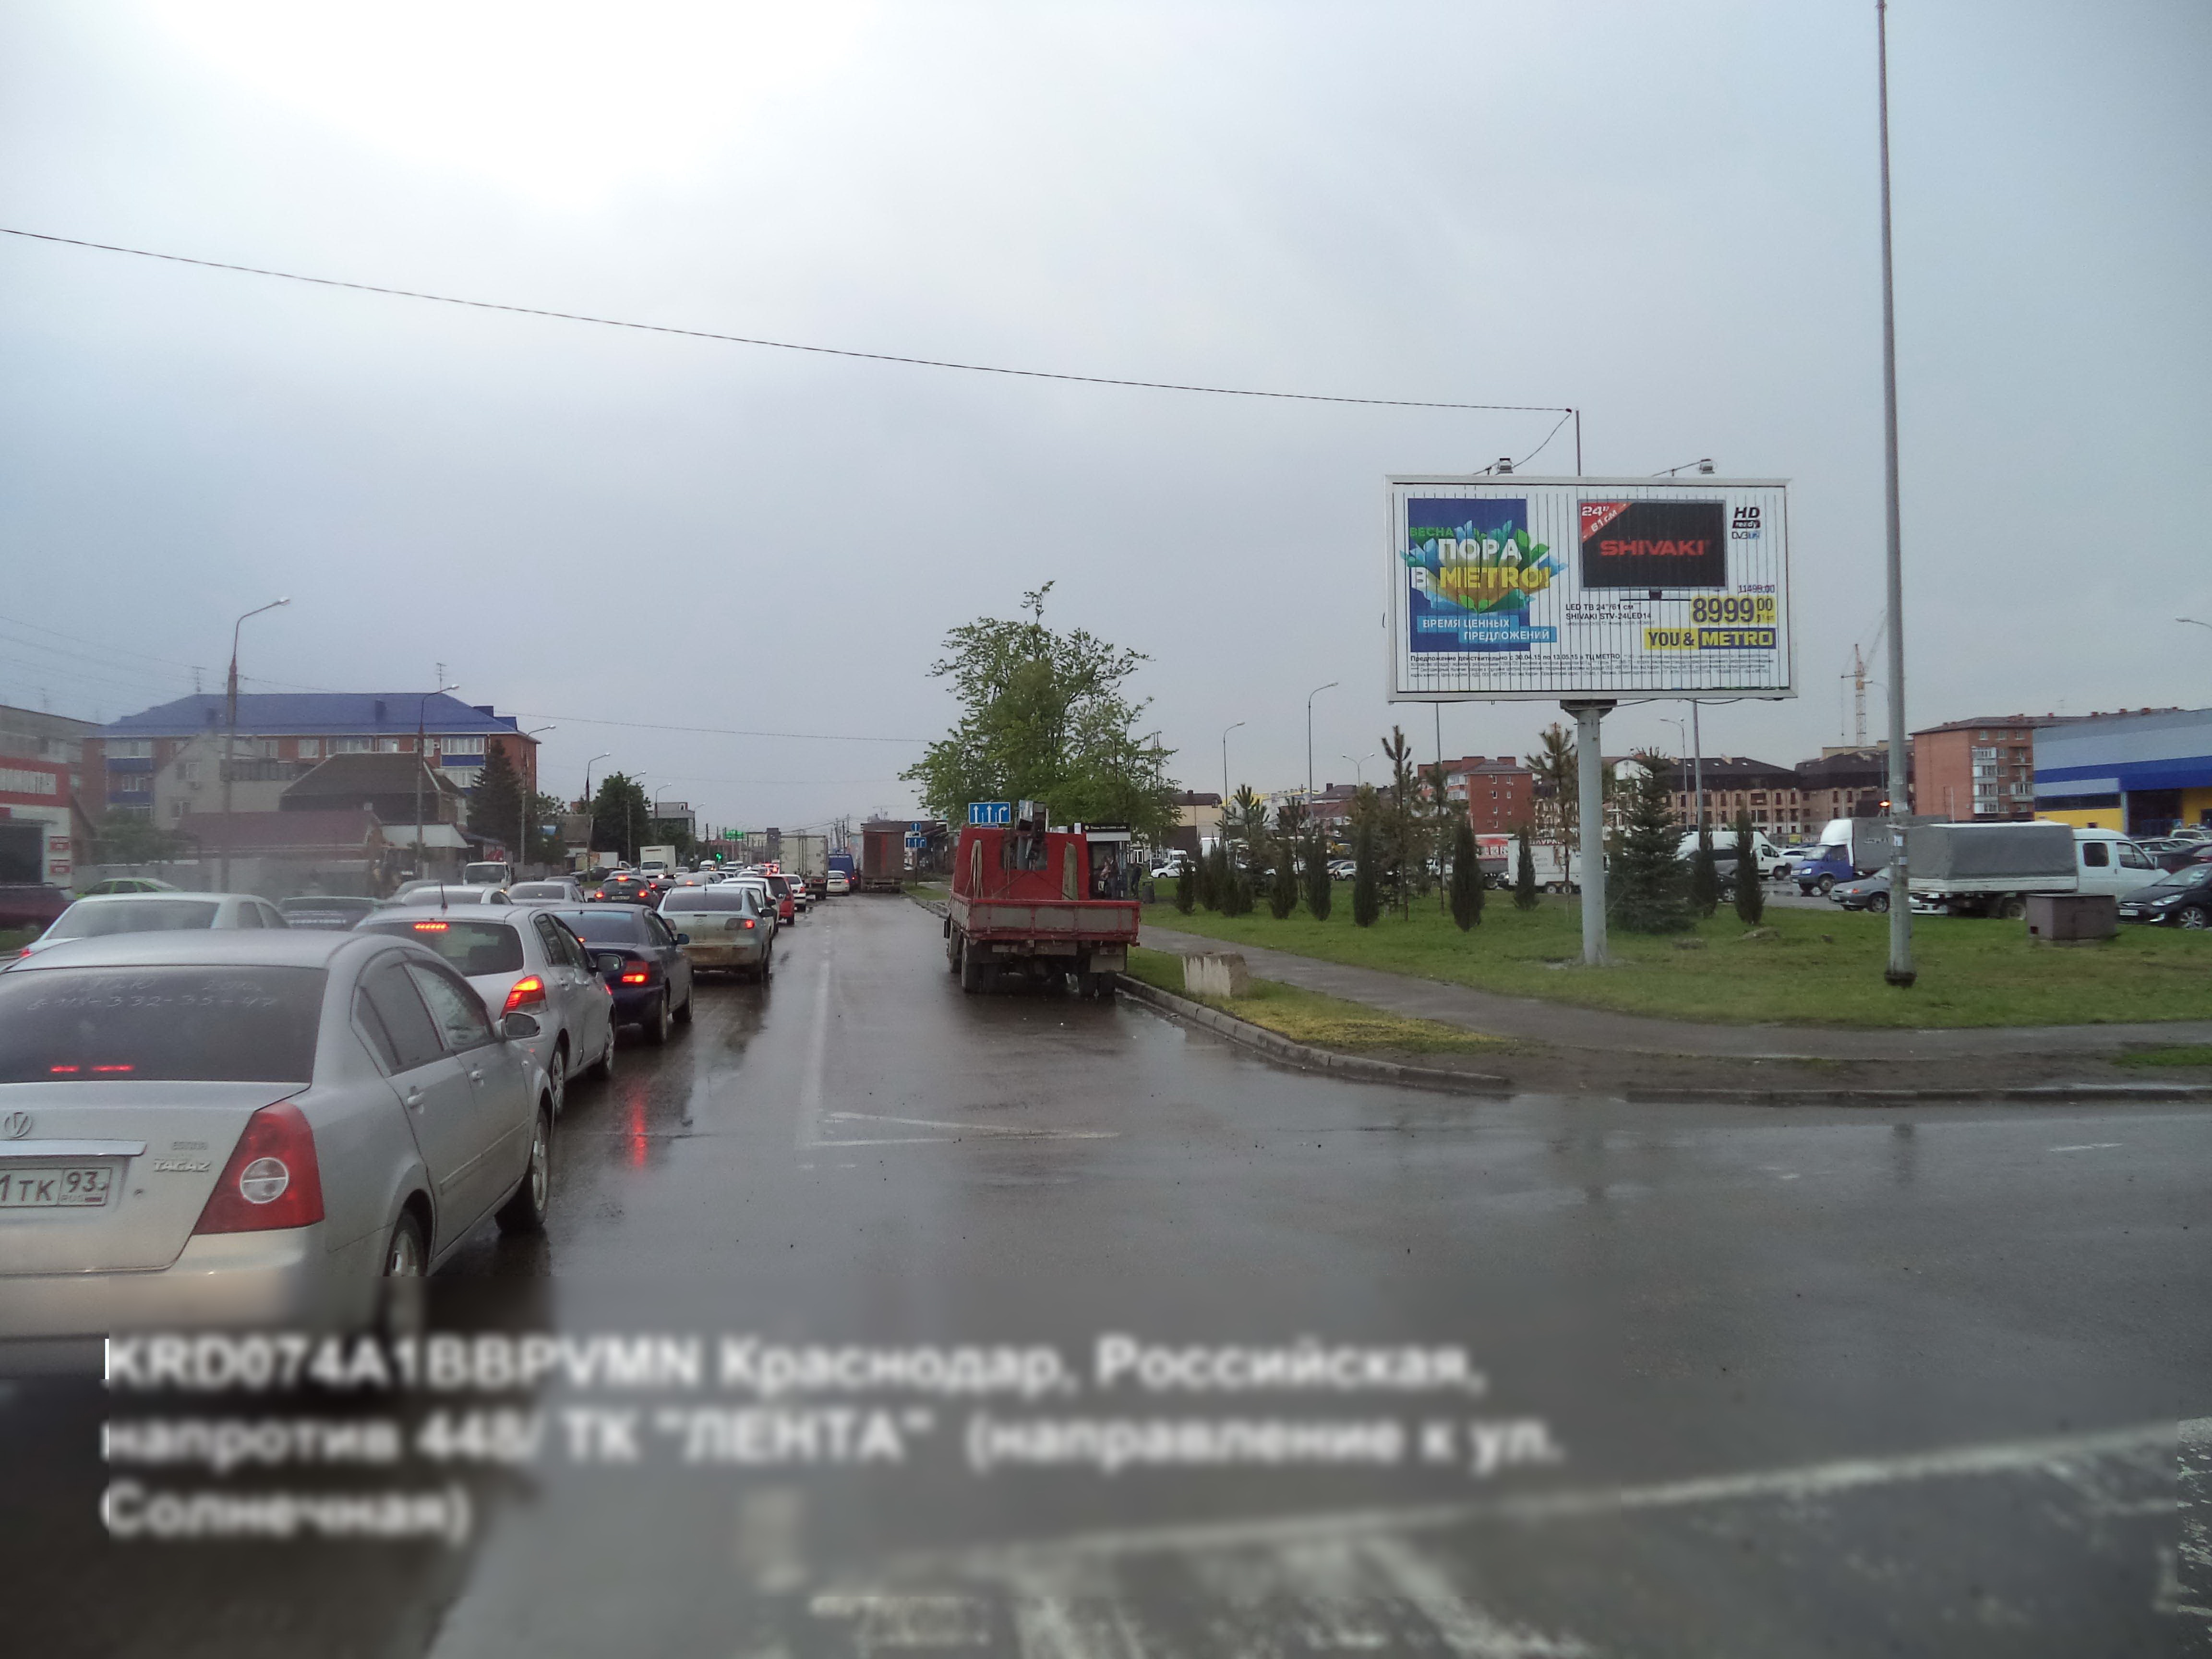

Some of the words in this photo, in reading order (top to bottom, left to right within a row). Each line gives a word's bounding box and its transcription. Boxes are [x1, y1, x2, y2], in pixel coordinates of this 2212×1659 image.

[1734, 507, 1760, 518] HD
[1409, 527, 1455, 537] ВЕСНА
[1438, 538, 1522, 561] ПОРА
[1600, 540, 1705, 556] SHIVAKI
[1411, 567, 1429, 588] В
[1440, 567, 1551, 588] METRO!
[1693, 598, 1754, 623] 8999
[1757, 598, 1774, 611] 00
[1422, 619, 1460, 628] ВРЕМЯ
[1464, 619, 1510, 629] ЦЕННЫХ
[1464, 629, 1550, 641] ПРЕДЛОЖЕНИЙ
[1648, 632, 1680, 646] YOU
[1683, 632, 1695, 646] &
[1702, 631, 1773, 646] METRO
[153, 1158, 211, 1172] TAGAZ
[67, 1171, 98, 1193] 93
